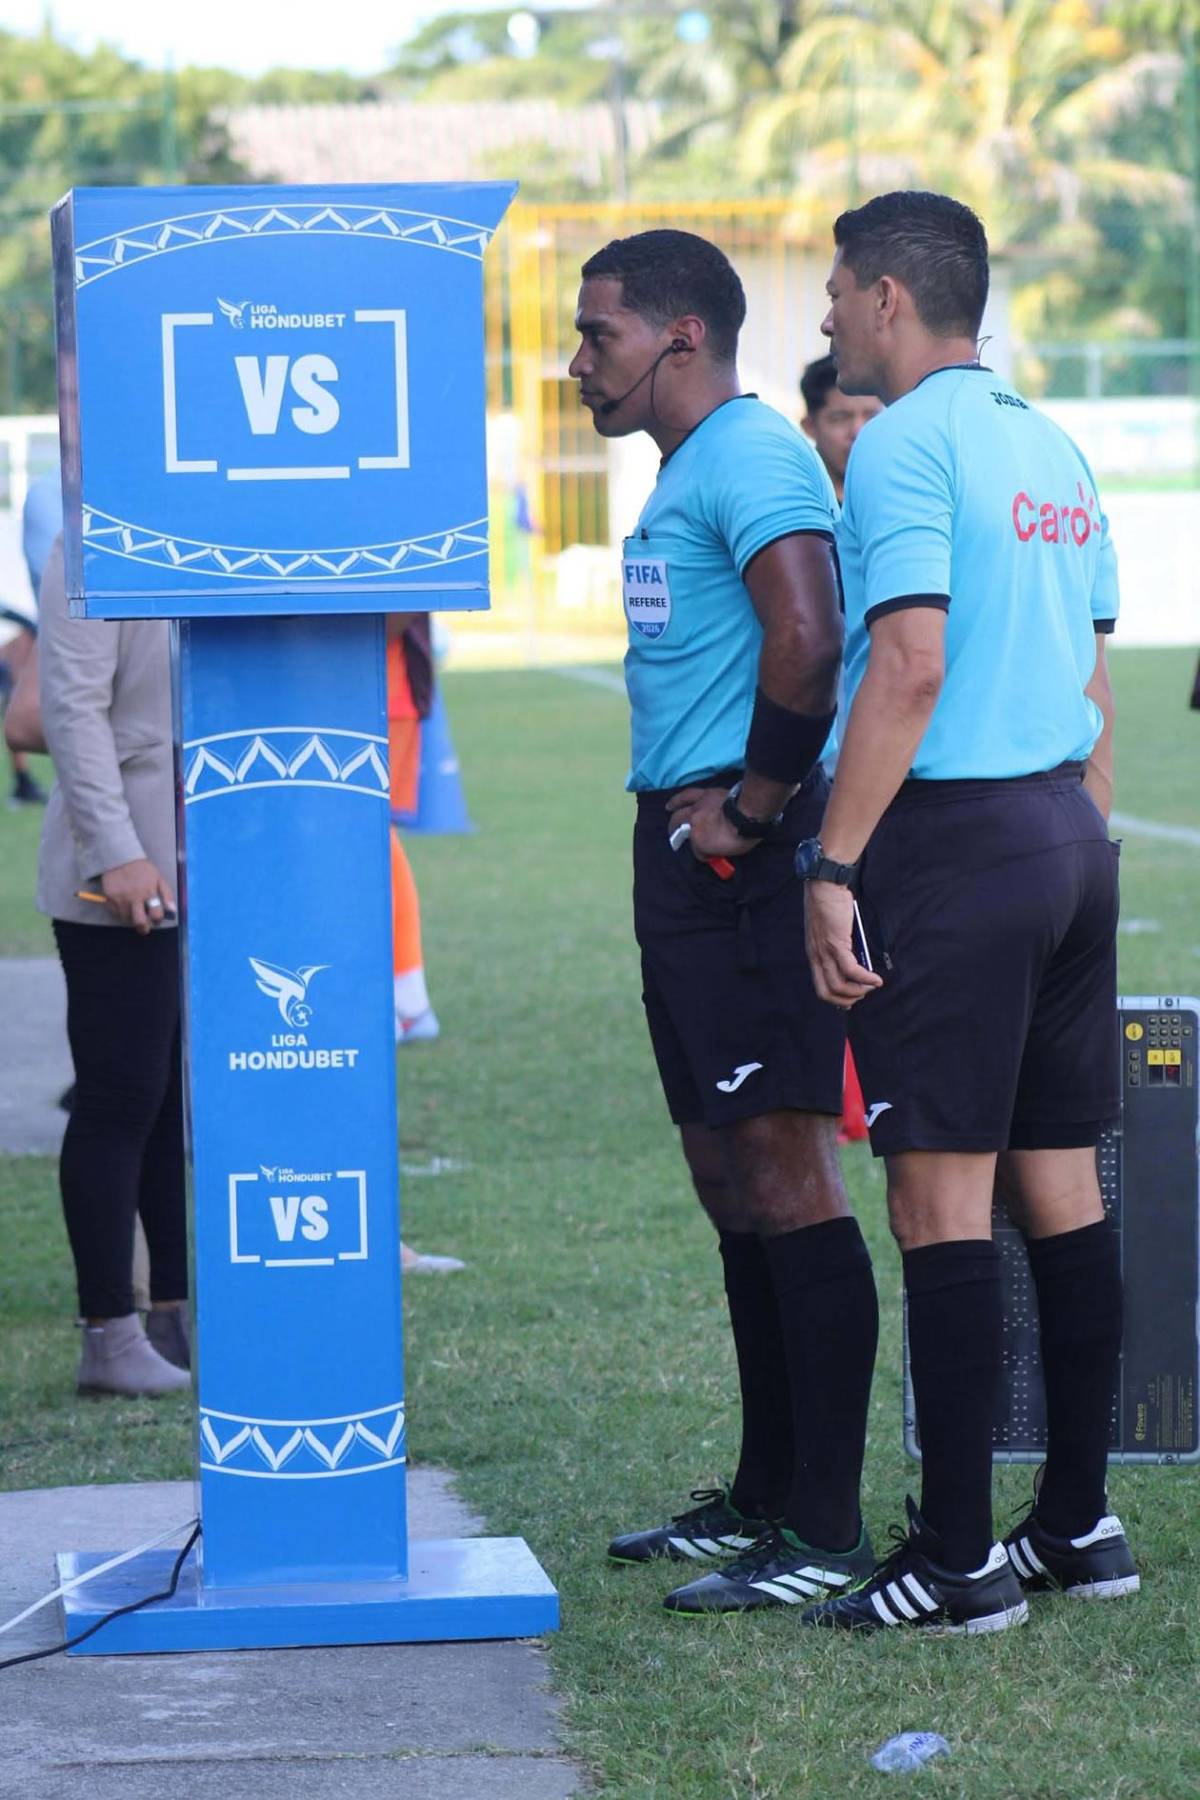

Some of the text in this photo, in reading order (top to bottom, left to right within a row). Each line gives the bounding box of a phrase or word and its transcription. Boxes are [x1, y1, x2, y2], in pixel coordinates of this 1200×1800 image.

[251, 305, 277, 314] LIGA
[251, 314, 346, 329] HONDUBET
[234, 354, 340, 434] VS
[625, 565, 662, 583] FIFA
[629, 597, 667, 608] REFEREE
[272, 1035, 308, 1047] LIGA
[229, 1050, 358, 1070] HONDUBET
[279, 1173, 333, 1183] HONDUBET
[269, 1195, 329, 1241] VS
